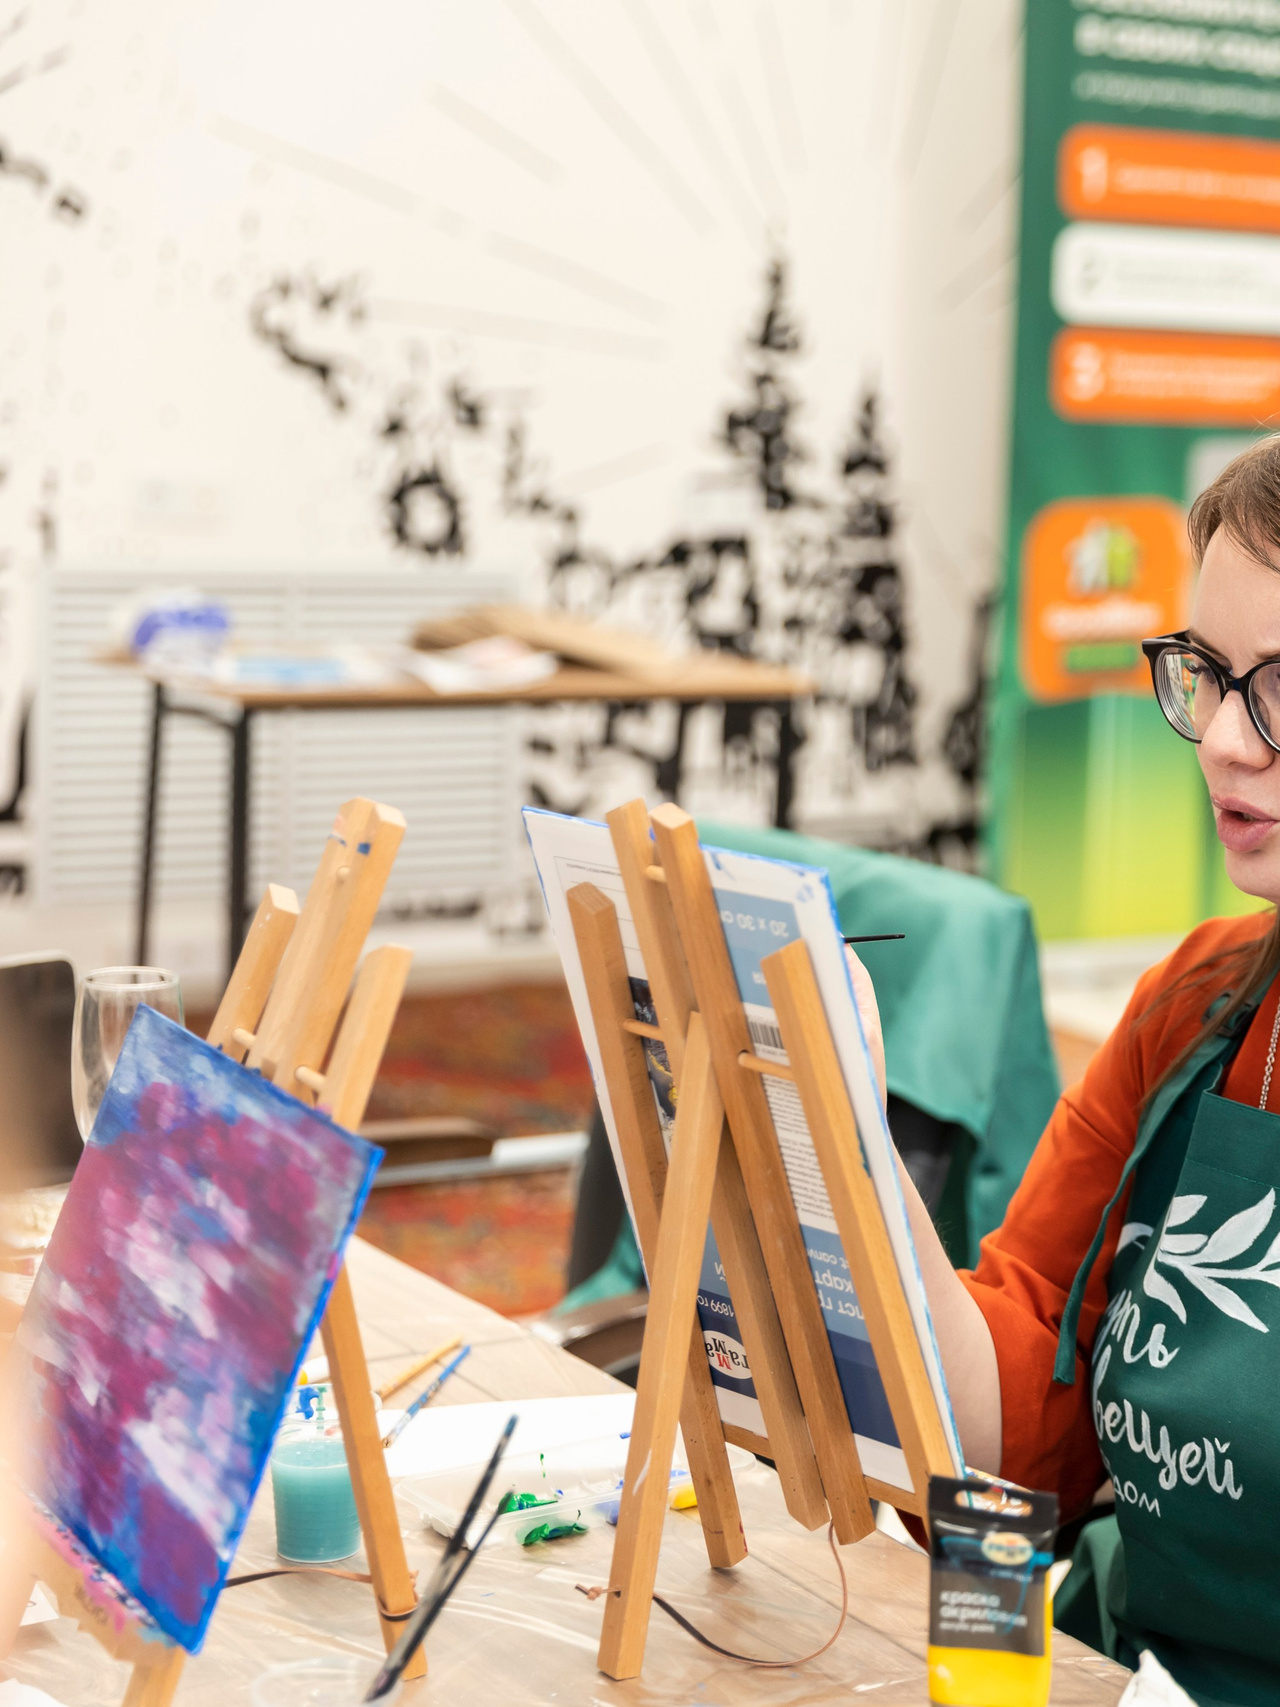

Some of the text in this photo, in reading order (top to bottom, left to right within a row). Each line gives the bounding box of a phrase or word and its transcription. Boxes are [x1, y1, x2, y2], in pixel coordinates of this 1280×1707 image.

[736, 912, 756, 932] 30
[814, 1268, 854, 1295] карт
[710, 1299, 735, 1318] 1899
[940, 1590, 1001, 1609] краска
